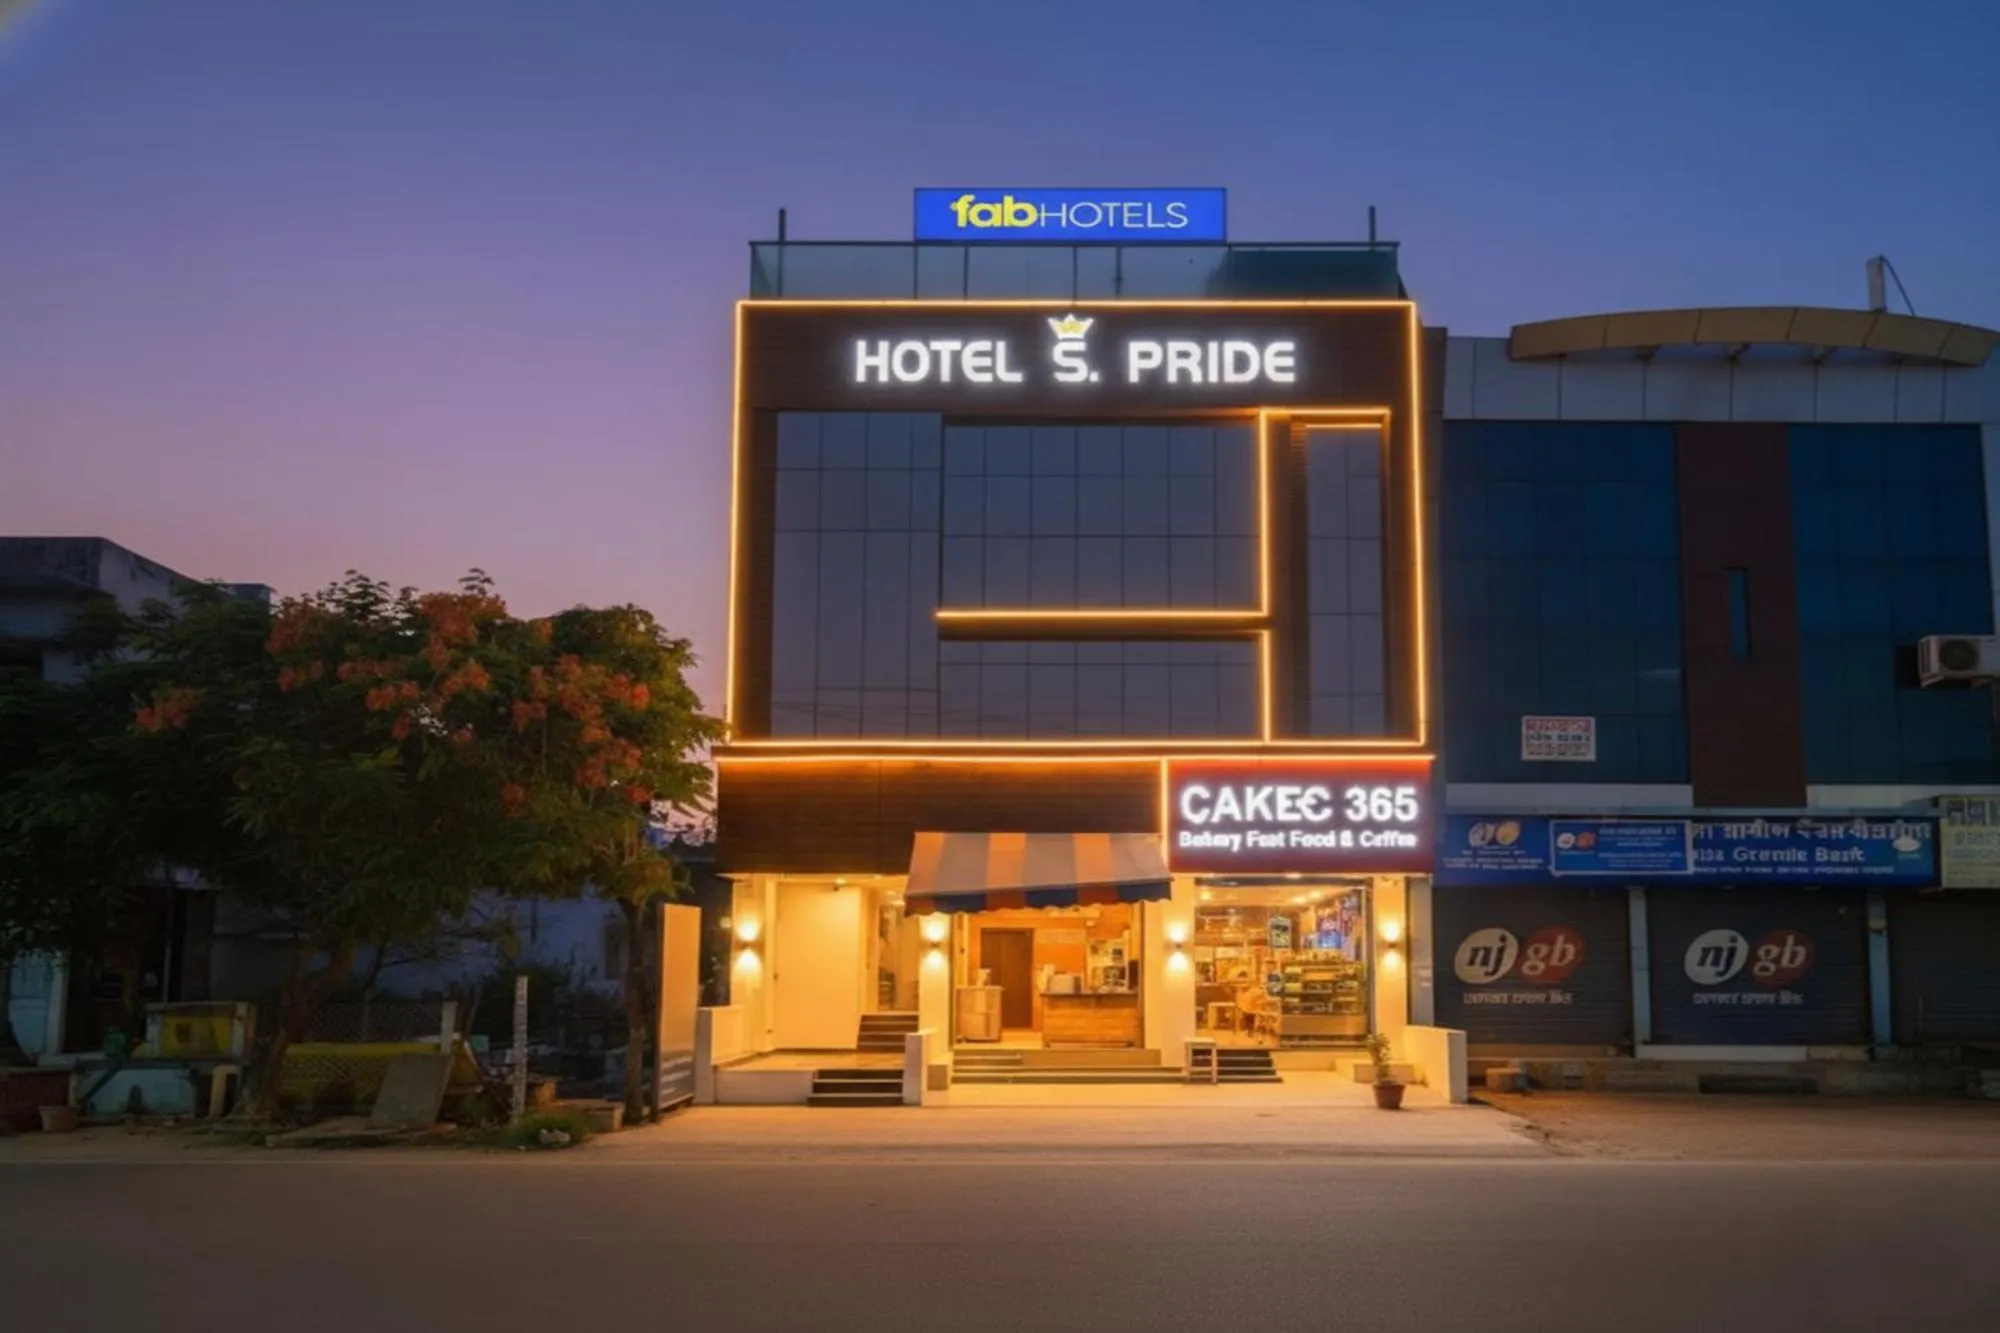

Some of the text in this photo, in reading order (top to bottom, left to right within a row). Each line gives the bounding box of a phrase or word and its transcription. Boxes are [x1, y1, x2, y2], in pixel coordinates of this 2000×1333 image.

[855, 339, 1297, 384] HOTEL S. PRIDE
[1344, 785, 1420, 823] 365
[1290, 830, 1336, 848] Food
